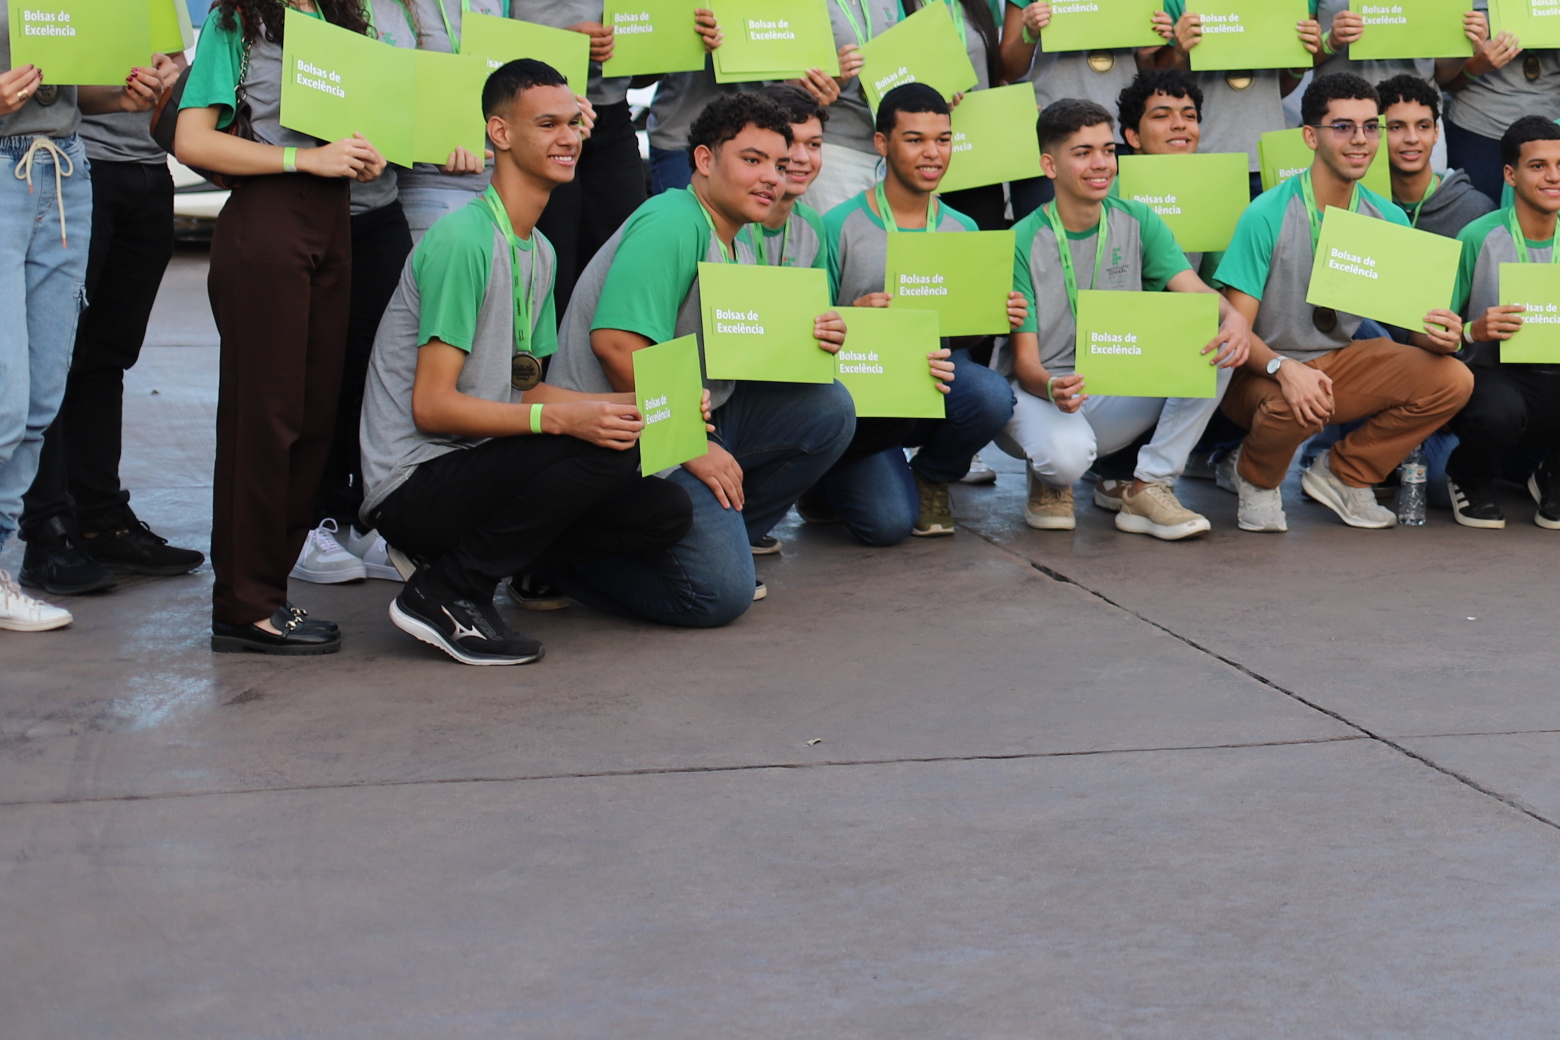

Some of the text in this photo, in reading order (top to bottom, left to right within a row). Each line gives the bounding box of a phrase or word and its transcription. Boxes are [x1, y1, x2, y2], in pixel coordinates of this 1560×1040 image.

[1052, 3, 1098, 14] Excelência
[1362, 5, 1402, 14] Bolsas de
[24, 10, 70, 22] Bolsas de
[614, 11, 650, 23] Bolsas de
[1199, 13, 1239, 23] Bolsas de
[1362, 16, 1407, 24] Excelência
[25, 24, 76, 36] Excelência
[614, 23, 653, 35] Excelência
[749, 20, 789, 29] Bolsas de
[1201, 24, 1244, 33] Excelência
[751, 31, 795, 40] Excelência
[297, 60, 341, 83] Bolsas de
[875, 66, 908, 90] Bolsas de
[297, 73, 346, 98] Excelência
[954, 132, 966, 141] de
[1164, 194, 1176, 203] de
[1331, 248, 1376, 267] Bolsas de
[1328, 259, 1378, 279] Excelência
[900, 274, 944, 283] Bolsas de
[900, 286, 948, 296] Excelência
[1545, 303, 1558, 312] de
[716, 309, 758, 320] Bolsas de
[717, 323, 764, 334] Excelência
[1092, 332, 1137, 342] Bolsas de
[1091, 344, 1142, 355] Excelência
[839, 351, 878, 361] Bolsas de
[840, 363, 883, 373] Excelência
[645, 394, 668, 410] Bolsas de
[646, 407, 671, 424] Excelência
